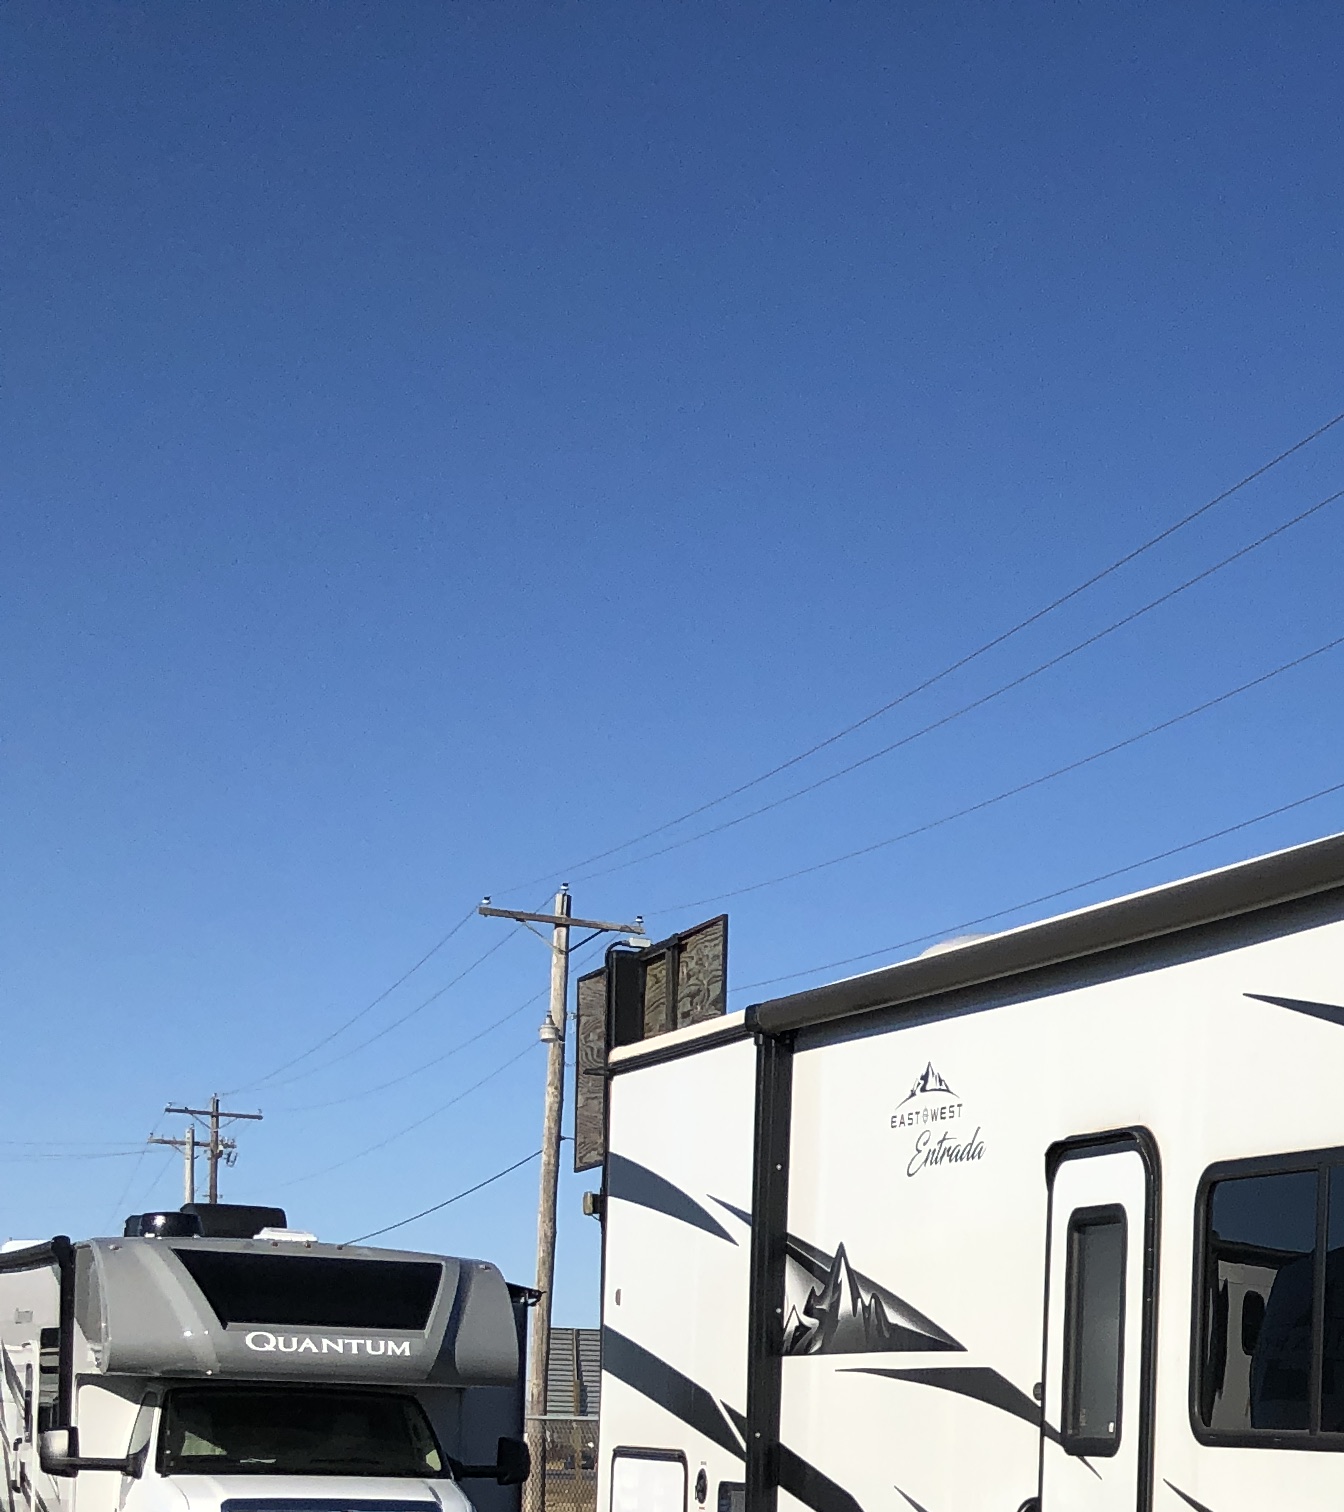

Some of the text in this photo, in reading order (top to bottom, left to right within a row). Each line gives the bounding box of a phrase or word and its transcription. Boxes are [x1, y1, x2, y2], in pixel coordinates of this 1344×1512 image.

[890, 1103, 963, 1129] EAST WEST
[906, 1126, 987, 1178] Entrada
[245, 1331, 411, 1356] QUANTUM
